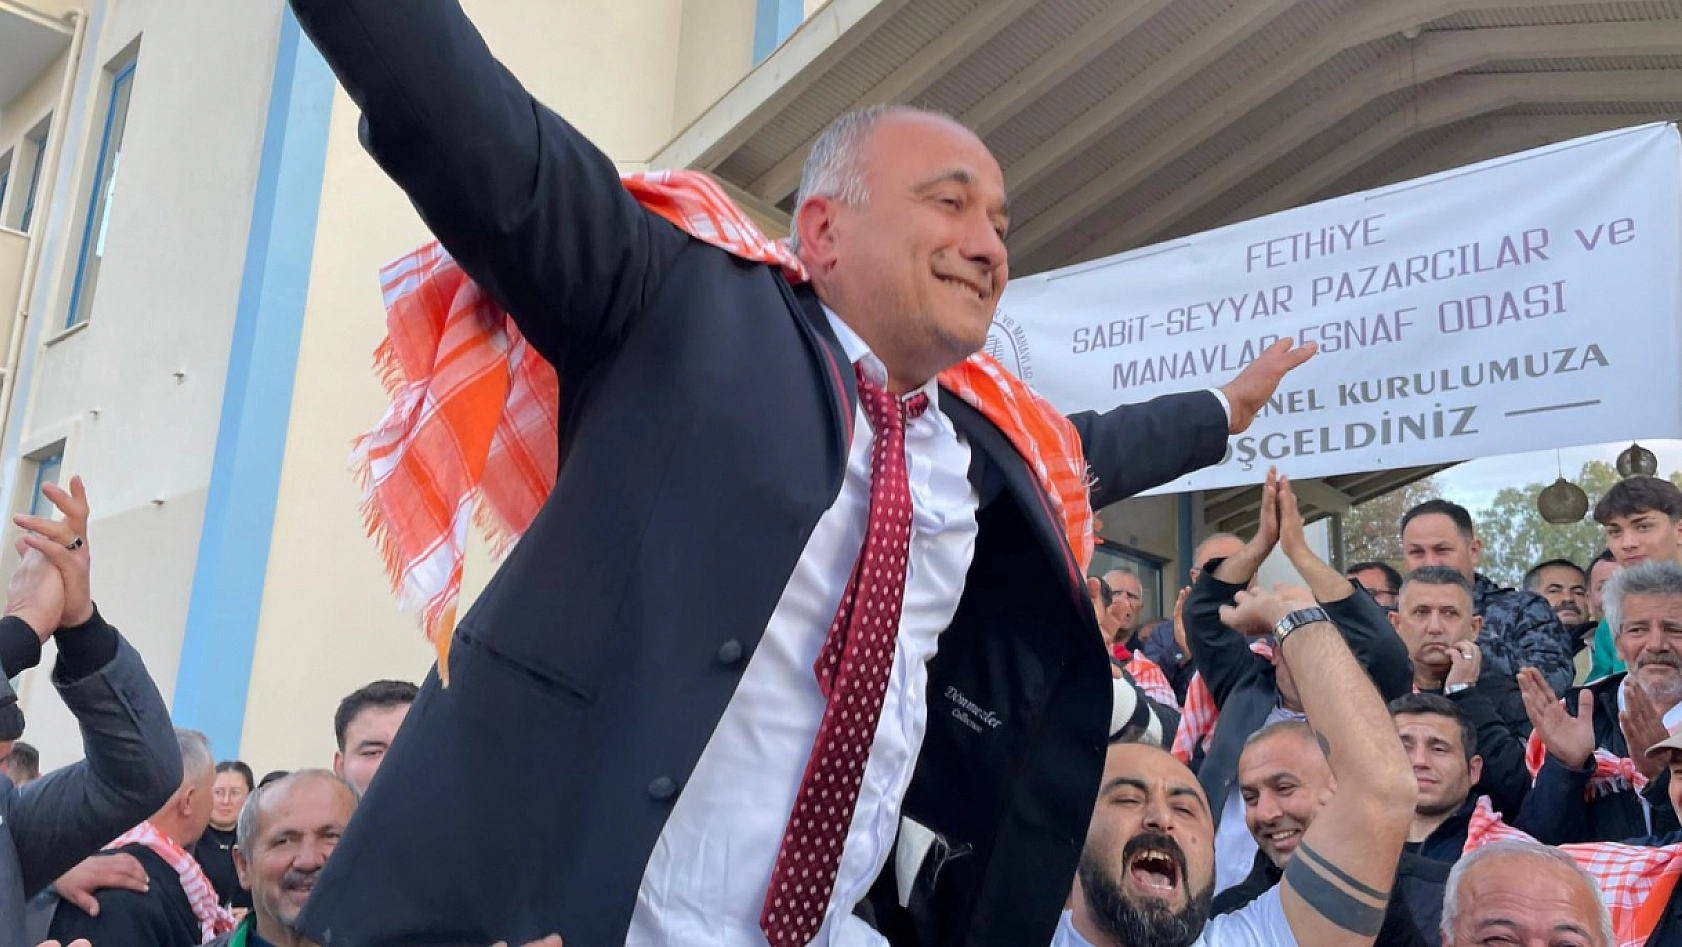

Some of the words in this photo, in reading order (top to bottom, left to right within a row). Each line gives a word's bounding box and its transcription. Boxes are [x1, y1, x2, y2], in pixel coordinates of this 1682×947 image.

[1311, 228, 1550, 308] PAZARCILAR
[1574, 217, 1636, 251] ve
[1438, 279, 1567, 334] ODASI
[1255, 388, 1325, 418] NEL
[1338, 343, 1611, 407] KURULUMUZA
[1220, 402, 1479, 471] ŞGELDİNİZ
